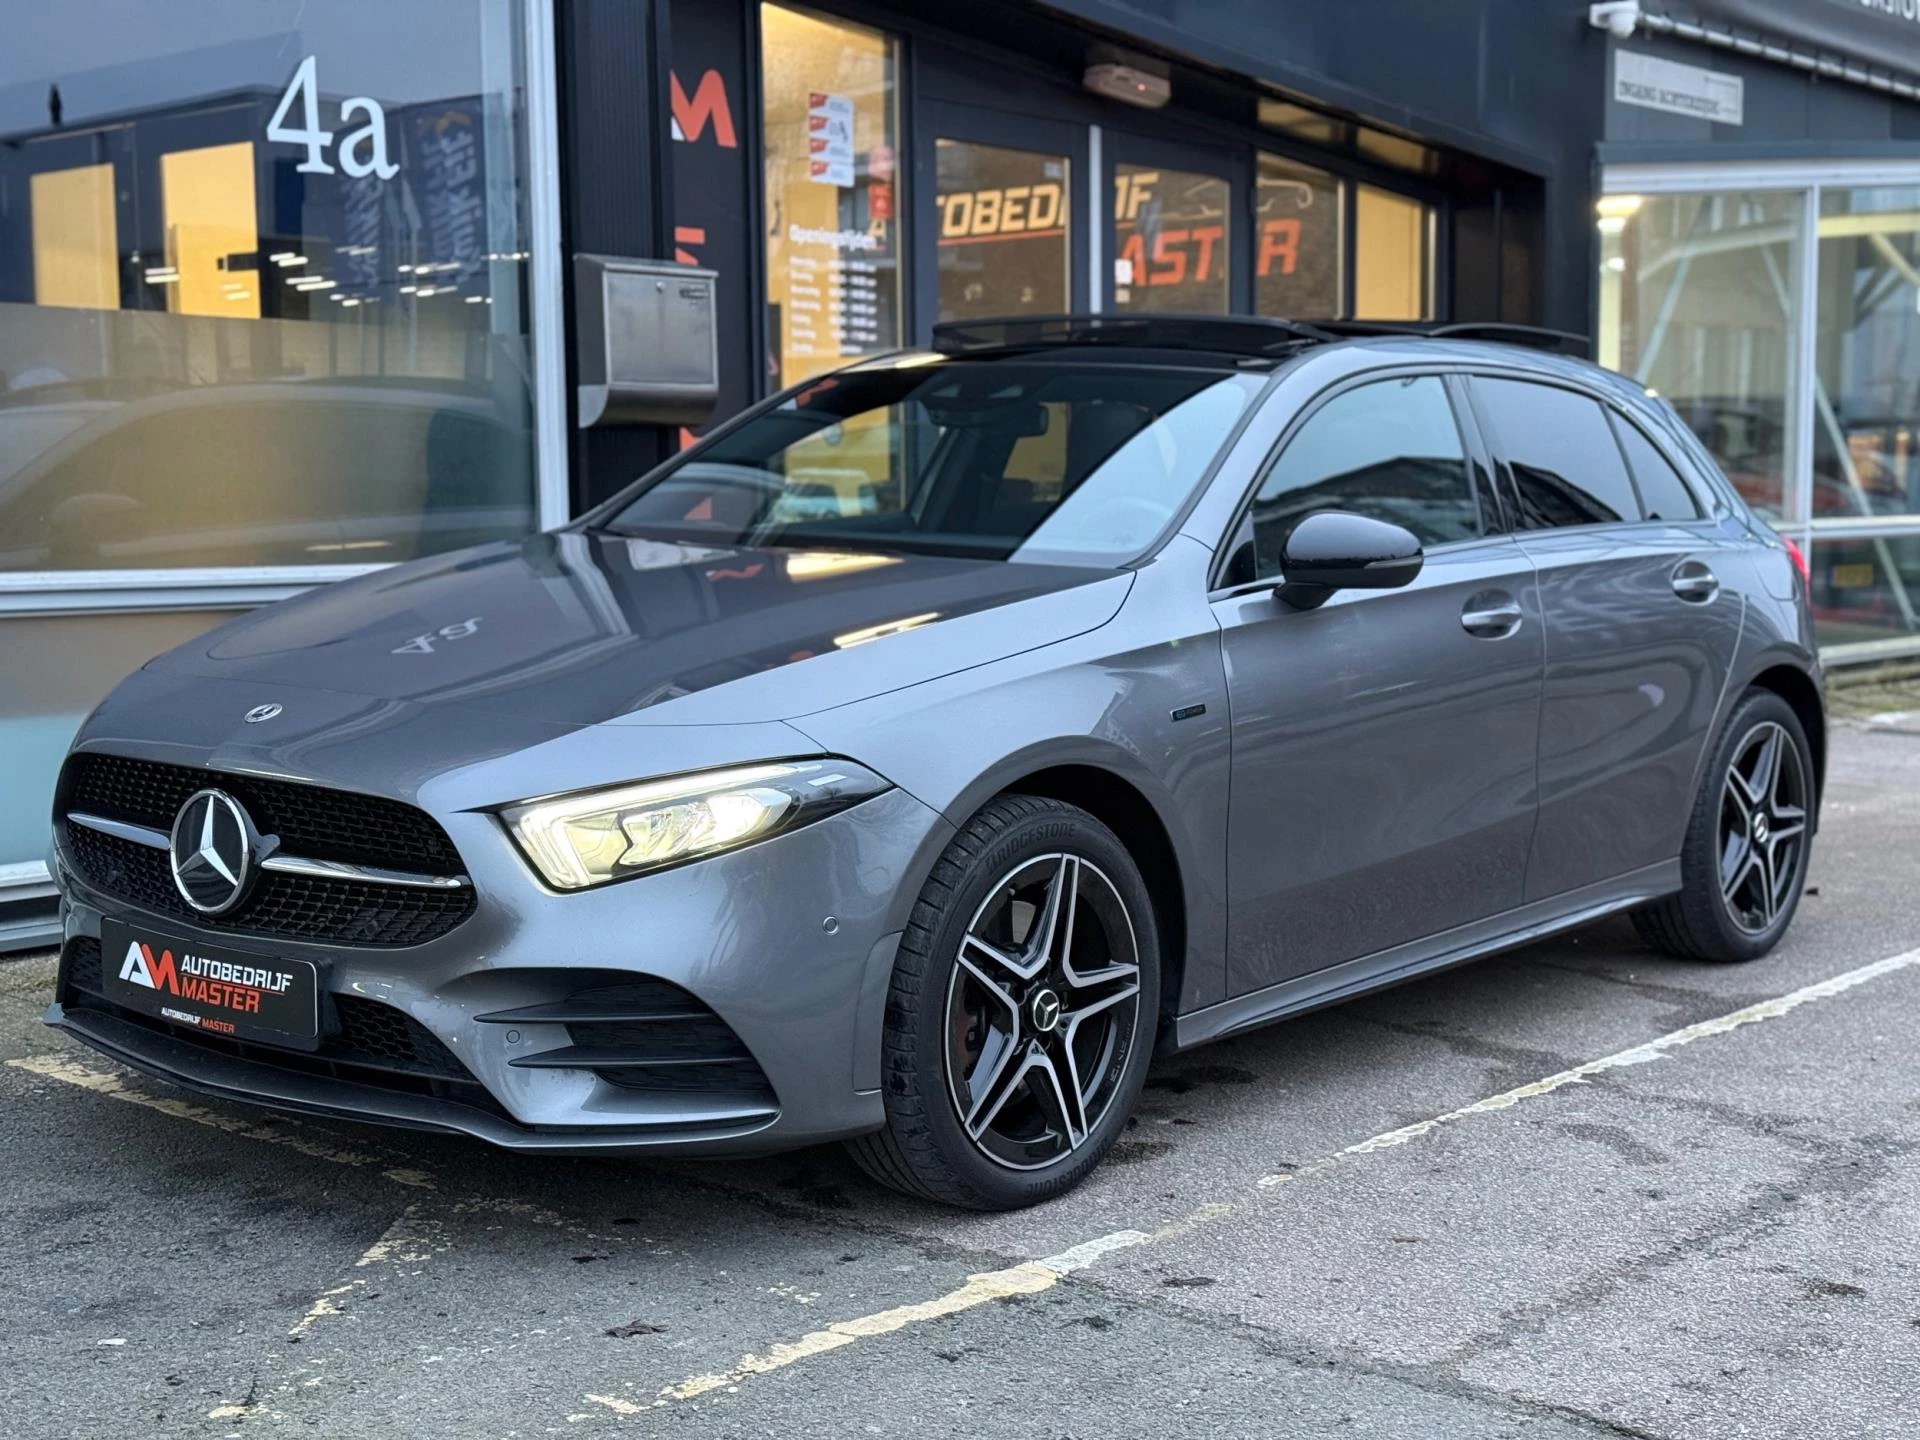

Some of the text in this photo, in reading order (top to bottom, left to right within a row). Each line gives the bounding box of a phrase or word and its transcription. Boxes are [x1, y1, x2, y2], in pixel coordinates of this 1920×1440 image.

[266, 54, 399, 181] 4a
[180, 954, 294, 993] AUTOBEDRIJF
[180, 979, 261, 1014] MASTER
[161, 1006, 202, 1025] AUTOBEDRIJF
[201, 1018, 236, 1034] MASTER
